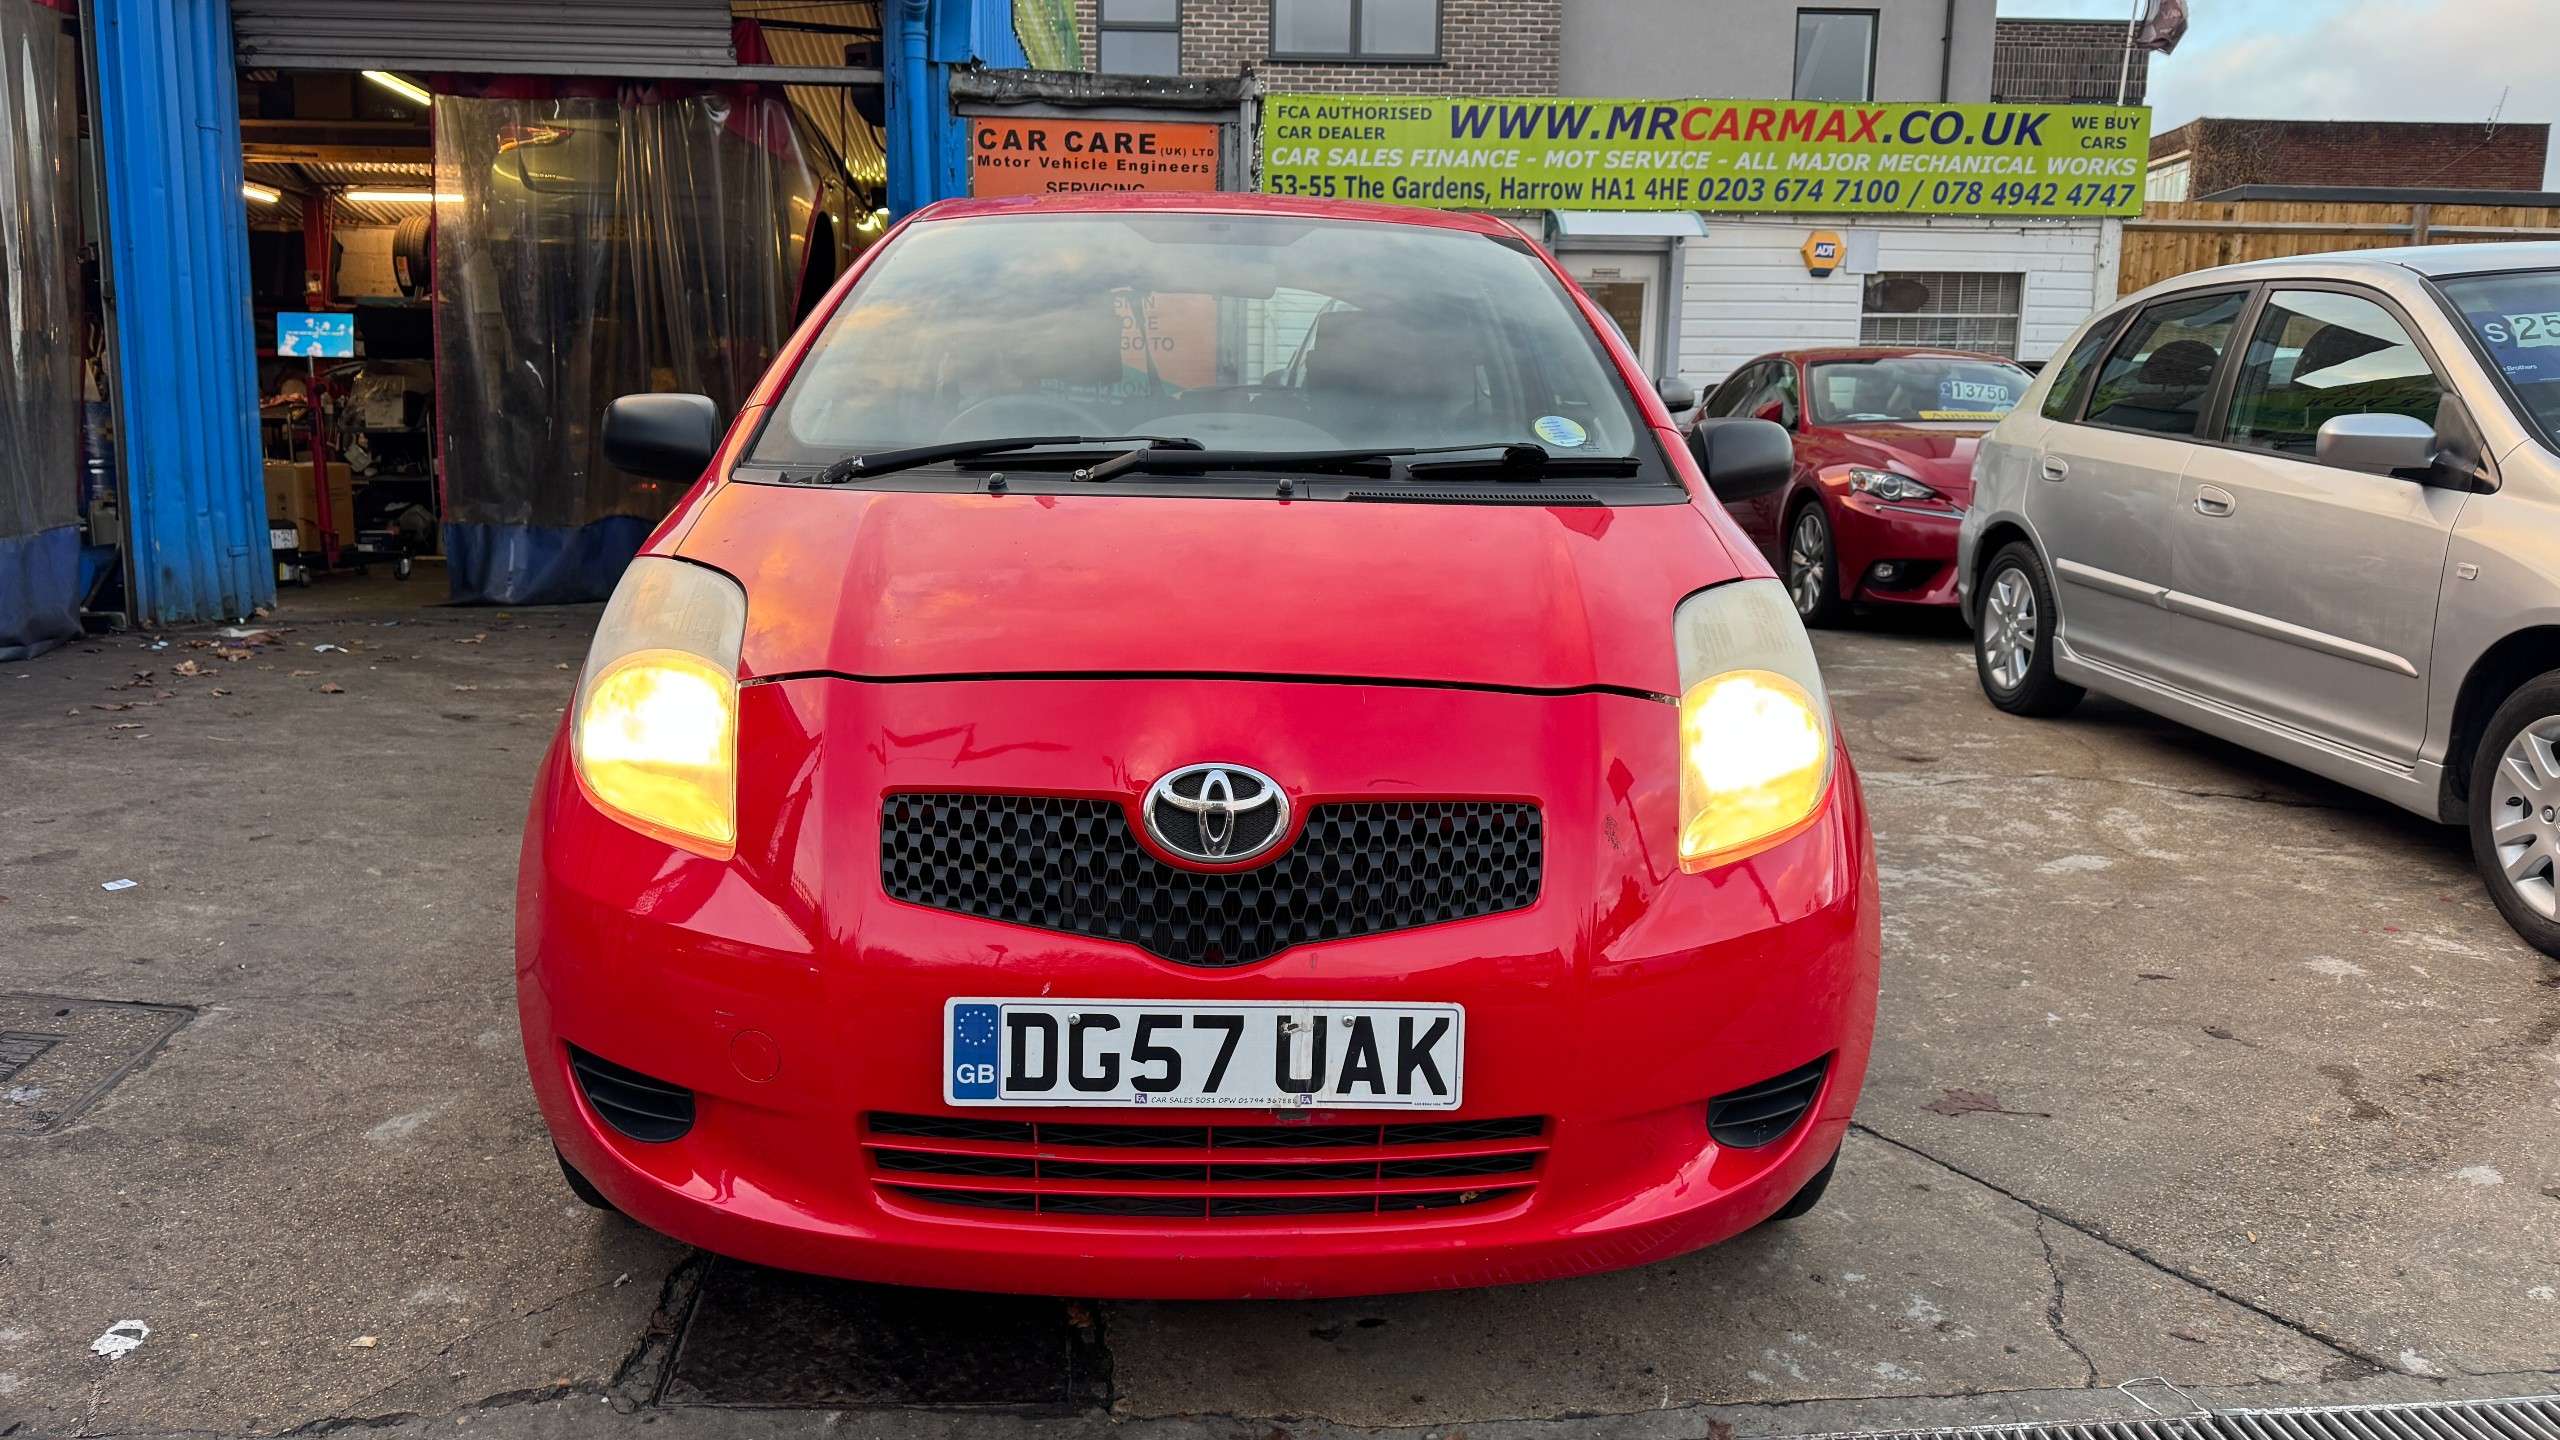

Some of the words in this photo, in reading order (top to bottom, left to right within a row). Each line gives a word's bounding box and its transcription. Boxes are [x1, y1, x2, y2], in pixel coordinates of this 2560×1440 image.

[1278, 106, 1311, 120] FCA
[1316, 106, 1432, 121] AUTHORISED
[2072, 116, 2099, 129] WE
[2104, 117, 2140, 130] BUY
[1277, 125, 1314, 140] CAR
[1319, 126, 1385, 140] DEALER
[1450, 105, 2049, 146] WWW.MRCARMAX.CO.UK
[977, 128, 1048, 152] CAR
[1064, 131, 1156, 155] CARE
[1160, 147, 1187, 158] (UK)
[1192, 148, 1215, 157] LTD
[2081, 136, 2127, 149] CARS
[977, 155, 1030, 168] Motor
[1039, 156, 1107, 171] Vehicle
[1117, 160, 1209, 174] Engineers
[1271, 147, 1323, 166] CAR
[1327, 148, 1402, 167] SALES
[1410, 149, 1520, 169] FINANCE
[1544, 150, 1599, 169] MOT
[1604, 151, 1709, 170] SERVICE
[1734, 153, 1778, 171] ALL
[1786, 153, 1871, 172] MAJOR
[1878, 155, 2036, 175] MECHANICAL
[2047, 158, 2137, 176] WORKS
[1271, 175, 1337, 197] 53-55
[1343, 175, 1384, 199] The
[1392, 176, 1491, 204] Gardens,
[1500, 177, 1581, 201] Harrow
[1591, 178, 1635, 200] HA1
[1645, 178, 1688, 201] 4HE
[1698, 178, 1764, 201] 0203
[1774, 179, 1823, 202] 674
[1835, 179, 1900, 203] 7100
[1906, 180, 1924, 208] /
[1932, 181, 1982, 205] 078
[1991, 182, 2056, 206] 4942
[2065, 183, 2135, 207] 4747
[1815, 244, 1836, 257] ADT
[1006, 1012, 1245, 1093] DG57
[1275, 1015, 1450, 1096] UAK
[956, 1064, 994, 1085] GB
[1151, 1096, 1166, 1104] CAR
[1169, 1096, 1193, 1104] SALES
